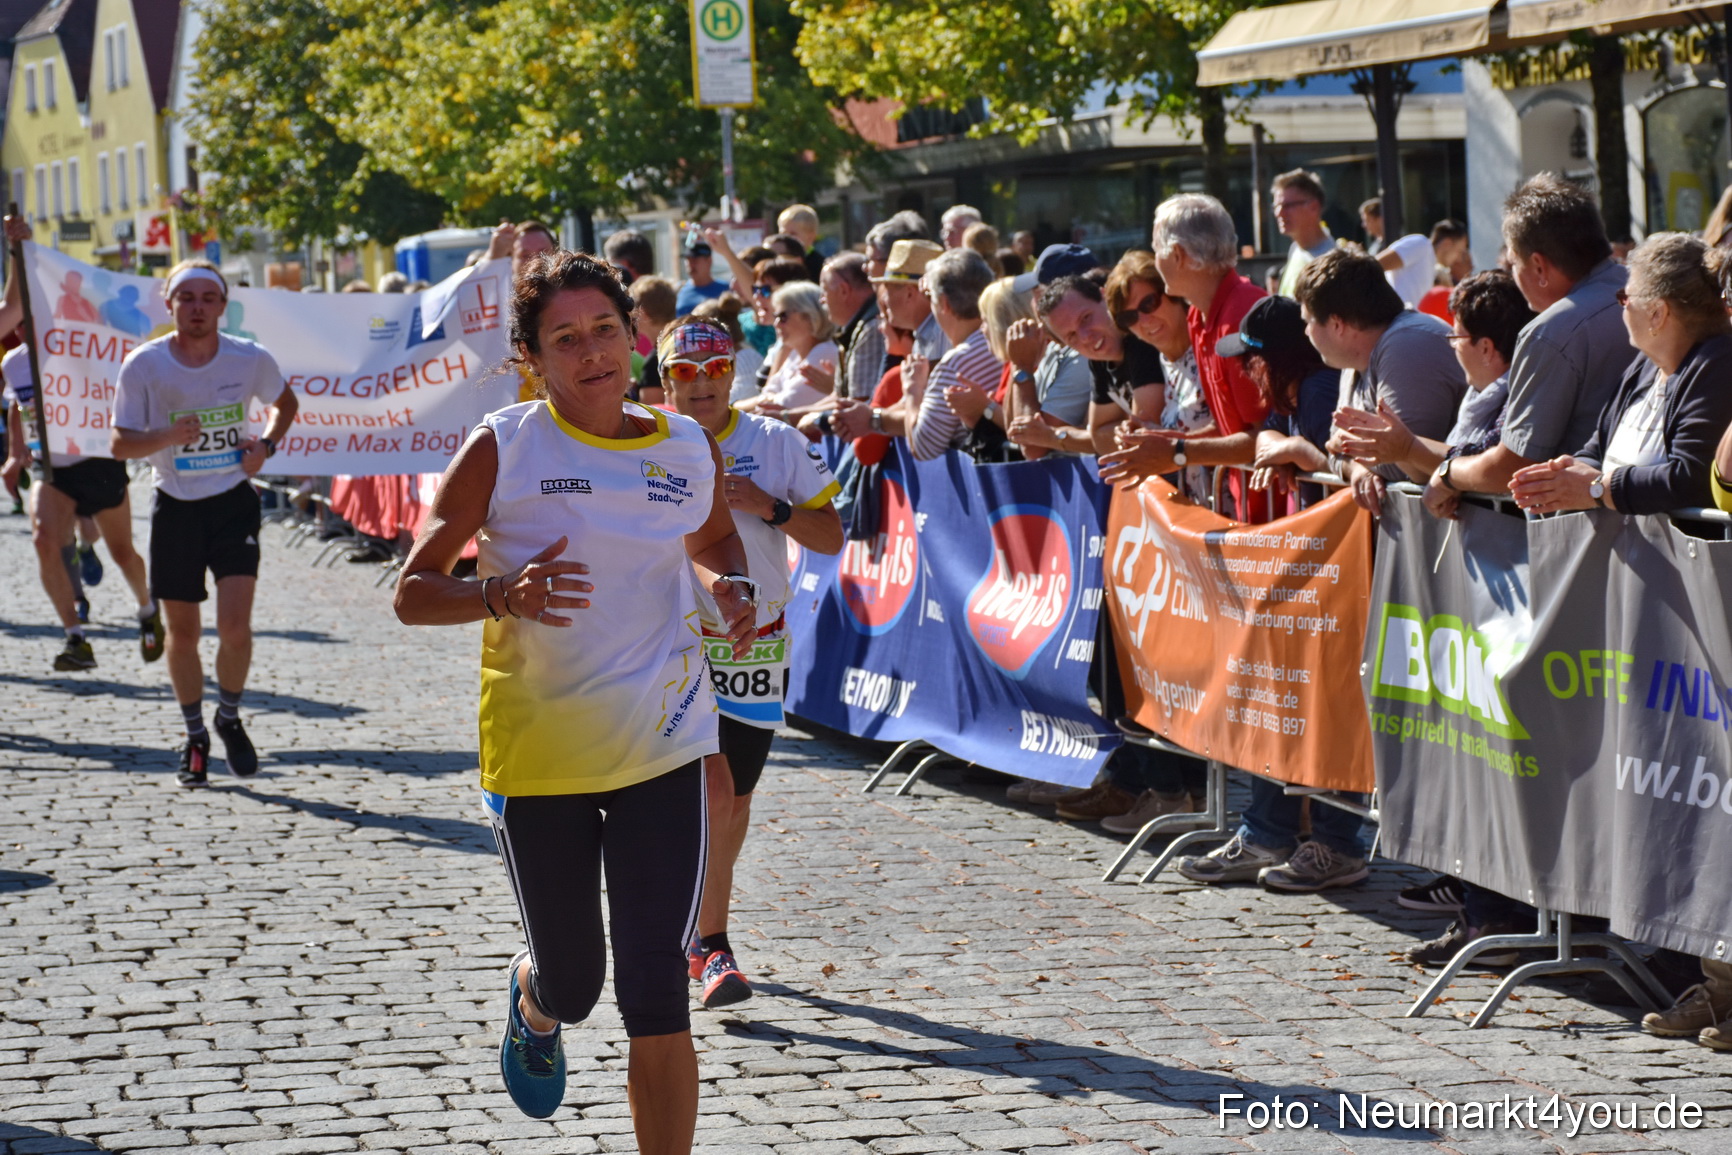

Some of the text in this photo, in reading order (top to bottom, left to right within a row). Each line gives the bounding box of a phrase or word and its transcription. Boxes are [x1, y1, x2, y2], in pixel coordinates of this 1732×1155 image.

[43, 328, 469, 399] GEME FOLGREICH
[43, 373, 71, 398] 20
[79, 377, 116, 401] Jah
[346, 433, 402, 454] Max
[541, 479, 591, 490] BOCK
[1284, 531, 1327, 551] Partner
[1256, 555, 1275, 575] und
[1274, 557, 1340, 585] Umsetzung
[1270, 584, 1319, 605] Internet,
[1297, 612, 1341, 637] angeht.
[1238, 657, 1253, 676] Sie
[1253, 660, 1270, 678] sich
[1269, 660, 1285, 682] bei
[1287, 668, 1311, 684] uns:
[1153, 670, 1206, 718] Agentur
[1282, 716, 1307, 737] 897
[1368, 703, 1446, 745] inspired
